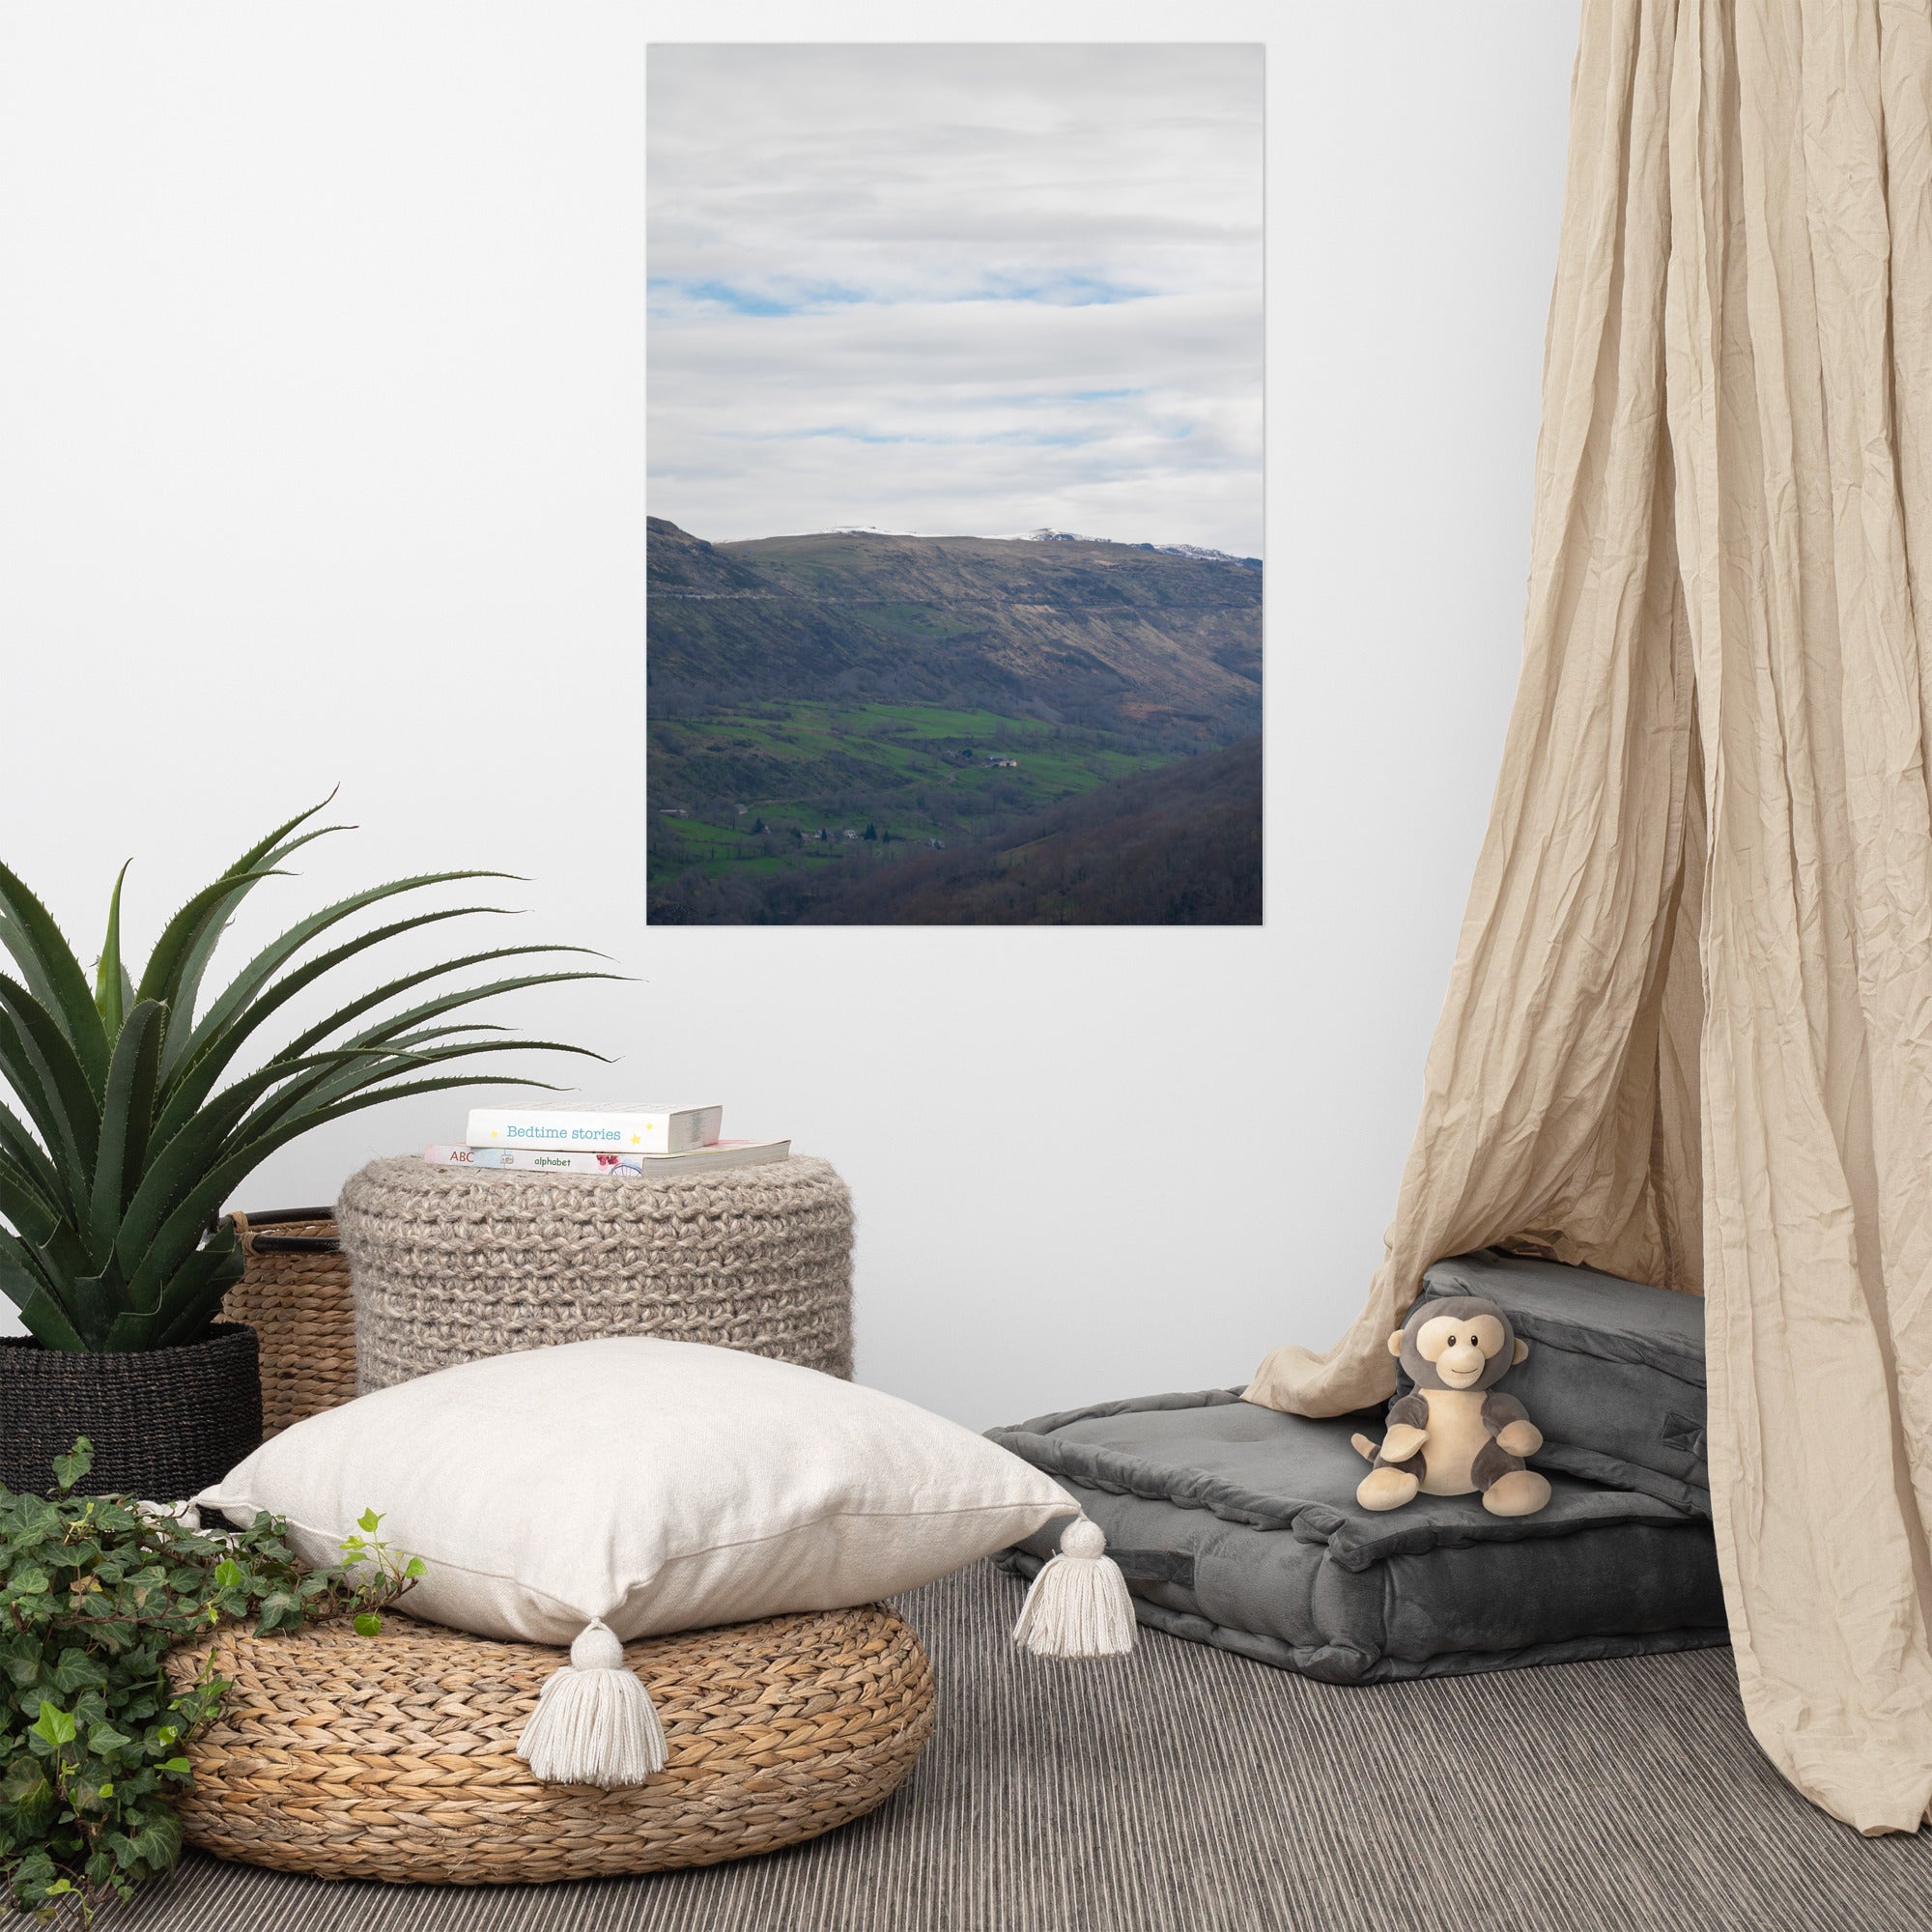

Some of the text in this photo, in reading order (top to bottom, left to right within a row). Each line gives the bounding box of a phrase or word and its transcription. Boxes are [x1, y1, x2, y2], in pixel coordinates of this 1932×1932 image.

[506, 1125, 621, 1141] Bedtime stories
[449, 1151, 475, 1163] ABC
[534, 1156, 572, 1167] alphabet
